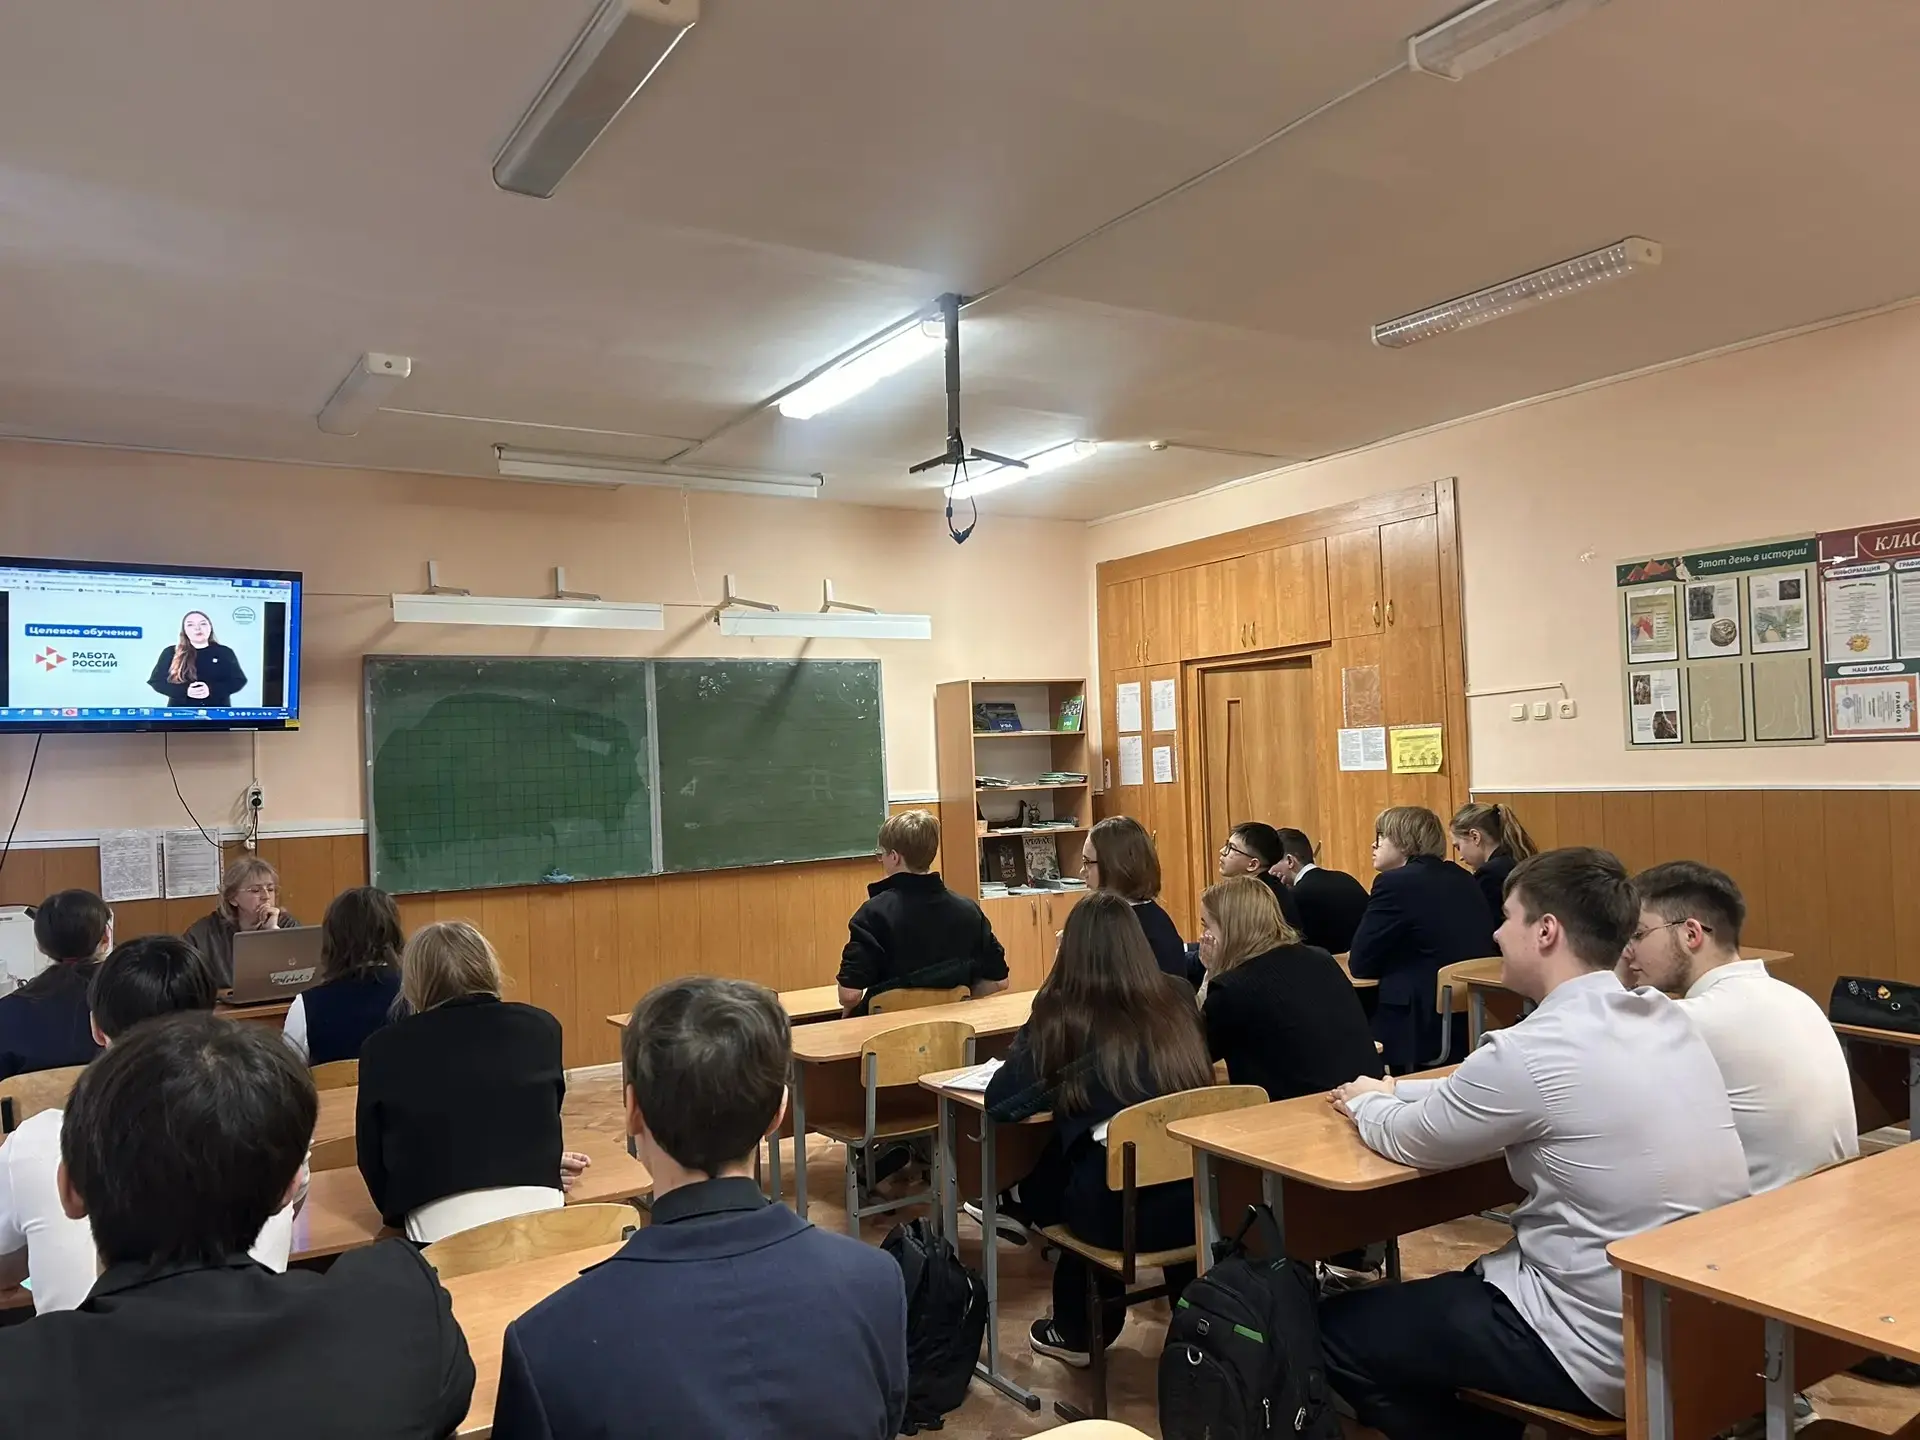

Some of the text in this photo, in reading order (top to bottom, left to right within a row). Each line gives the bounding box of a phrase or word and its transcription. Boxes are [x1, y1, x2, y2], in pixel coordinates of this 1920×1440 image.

[1697, 558, 1727, 569] Этот
[1728, 555, 1752, 565] день
[1761, 547, 1807, 559] истории
[1833, 565, 1881, 576] ИНФОРМАЦИЯ
[29, 626, 139, 637] Целевое обучение
[72, 651, 116, 660] РАБОТА
[72, 660, 118, 668] РОССИИ
